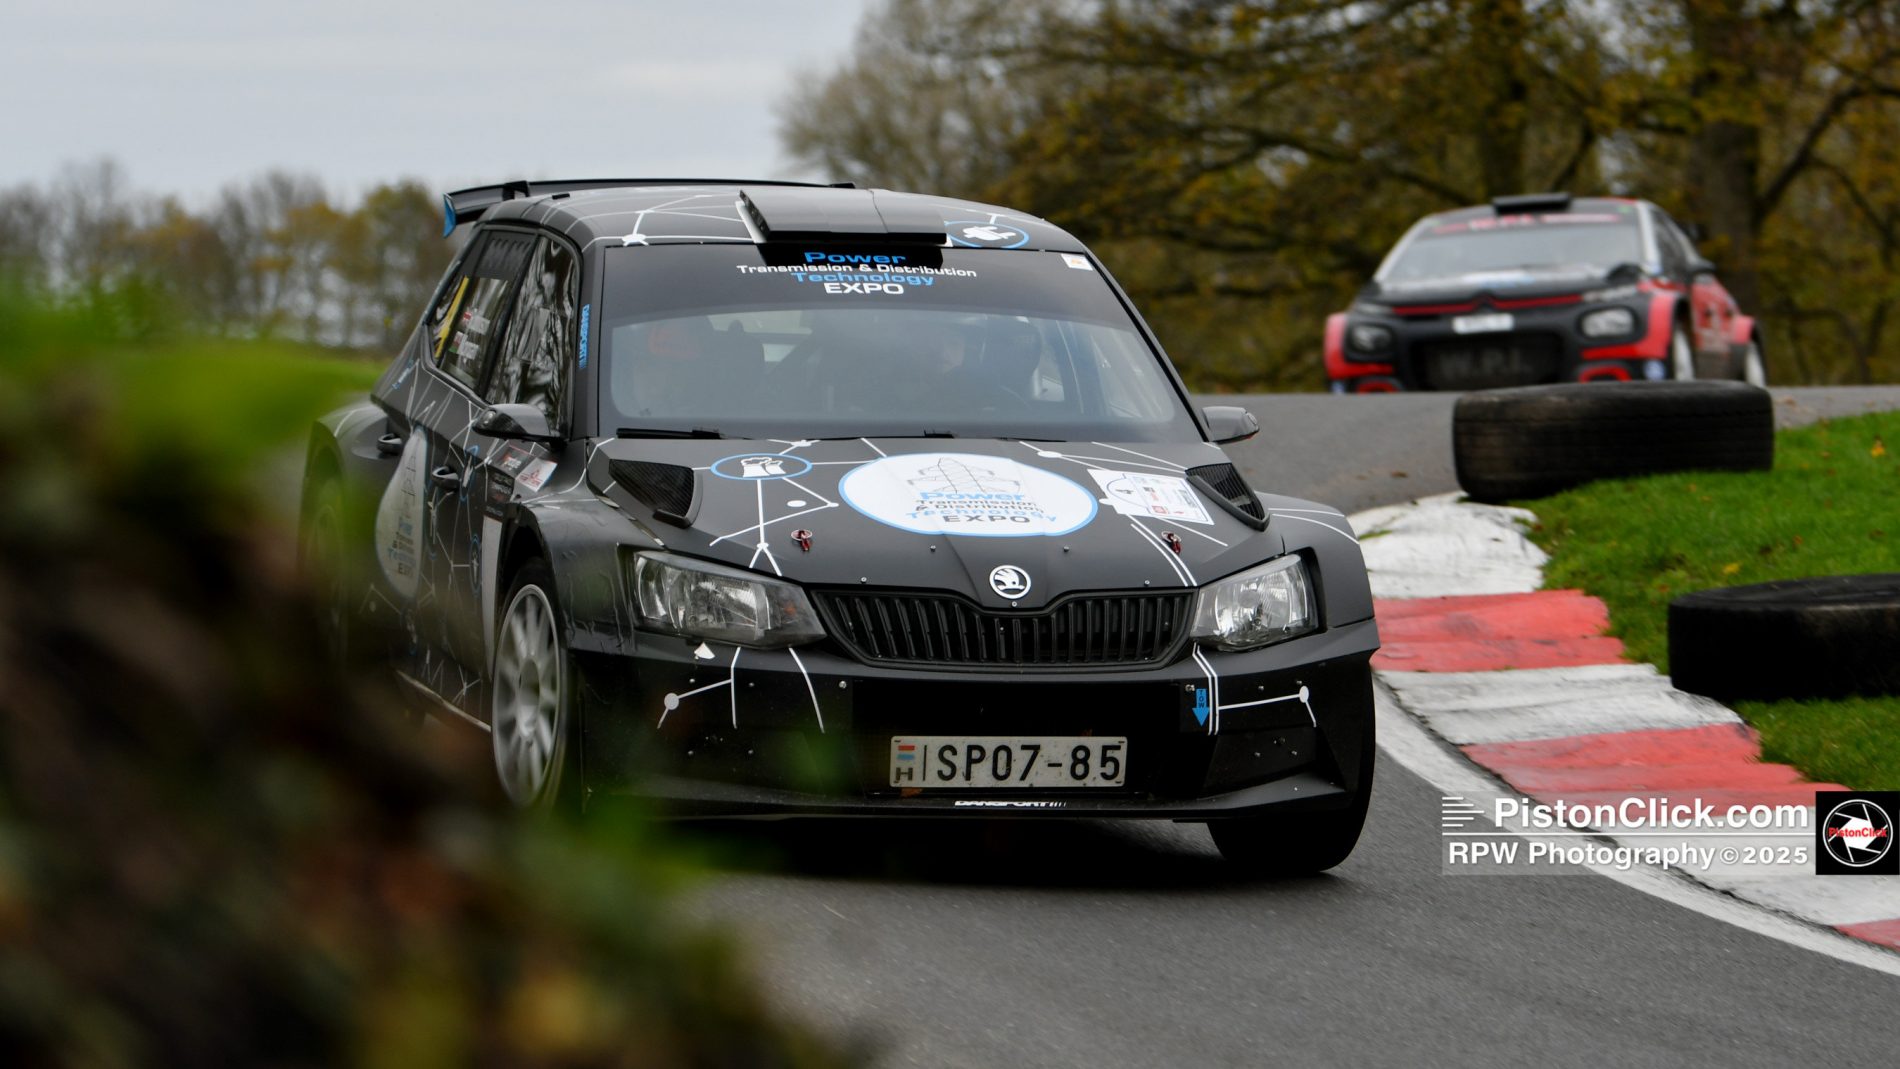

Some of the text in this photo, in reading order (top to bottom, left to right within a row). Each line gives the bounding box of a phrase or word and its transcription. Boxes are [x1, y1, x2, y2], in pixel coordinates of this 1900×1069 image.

[804, 251, 906, 264] Power
[736, 263, 977, 278] Transmission & Distribution
[791, 272, 935, 286] Technology
[824, 282, 905, 295] EXPO
[920, 491, 1025, 501] Power
[916, 499, 1037, 507] Transmission
[934, 504, 1044, 514] Distribution
[905, 508, 1057, 523] Technology
[942, 515, 1031, 524] EXPO
[895, 743, 1123, 782] H SP07-85
